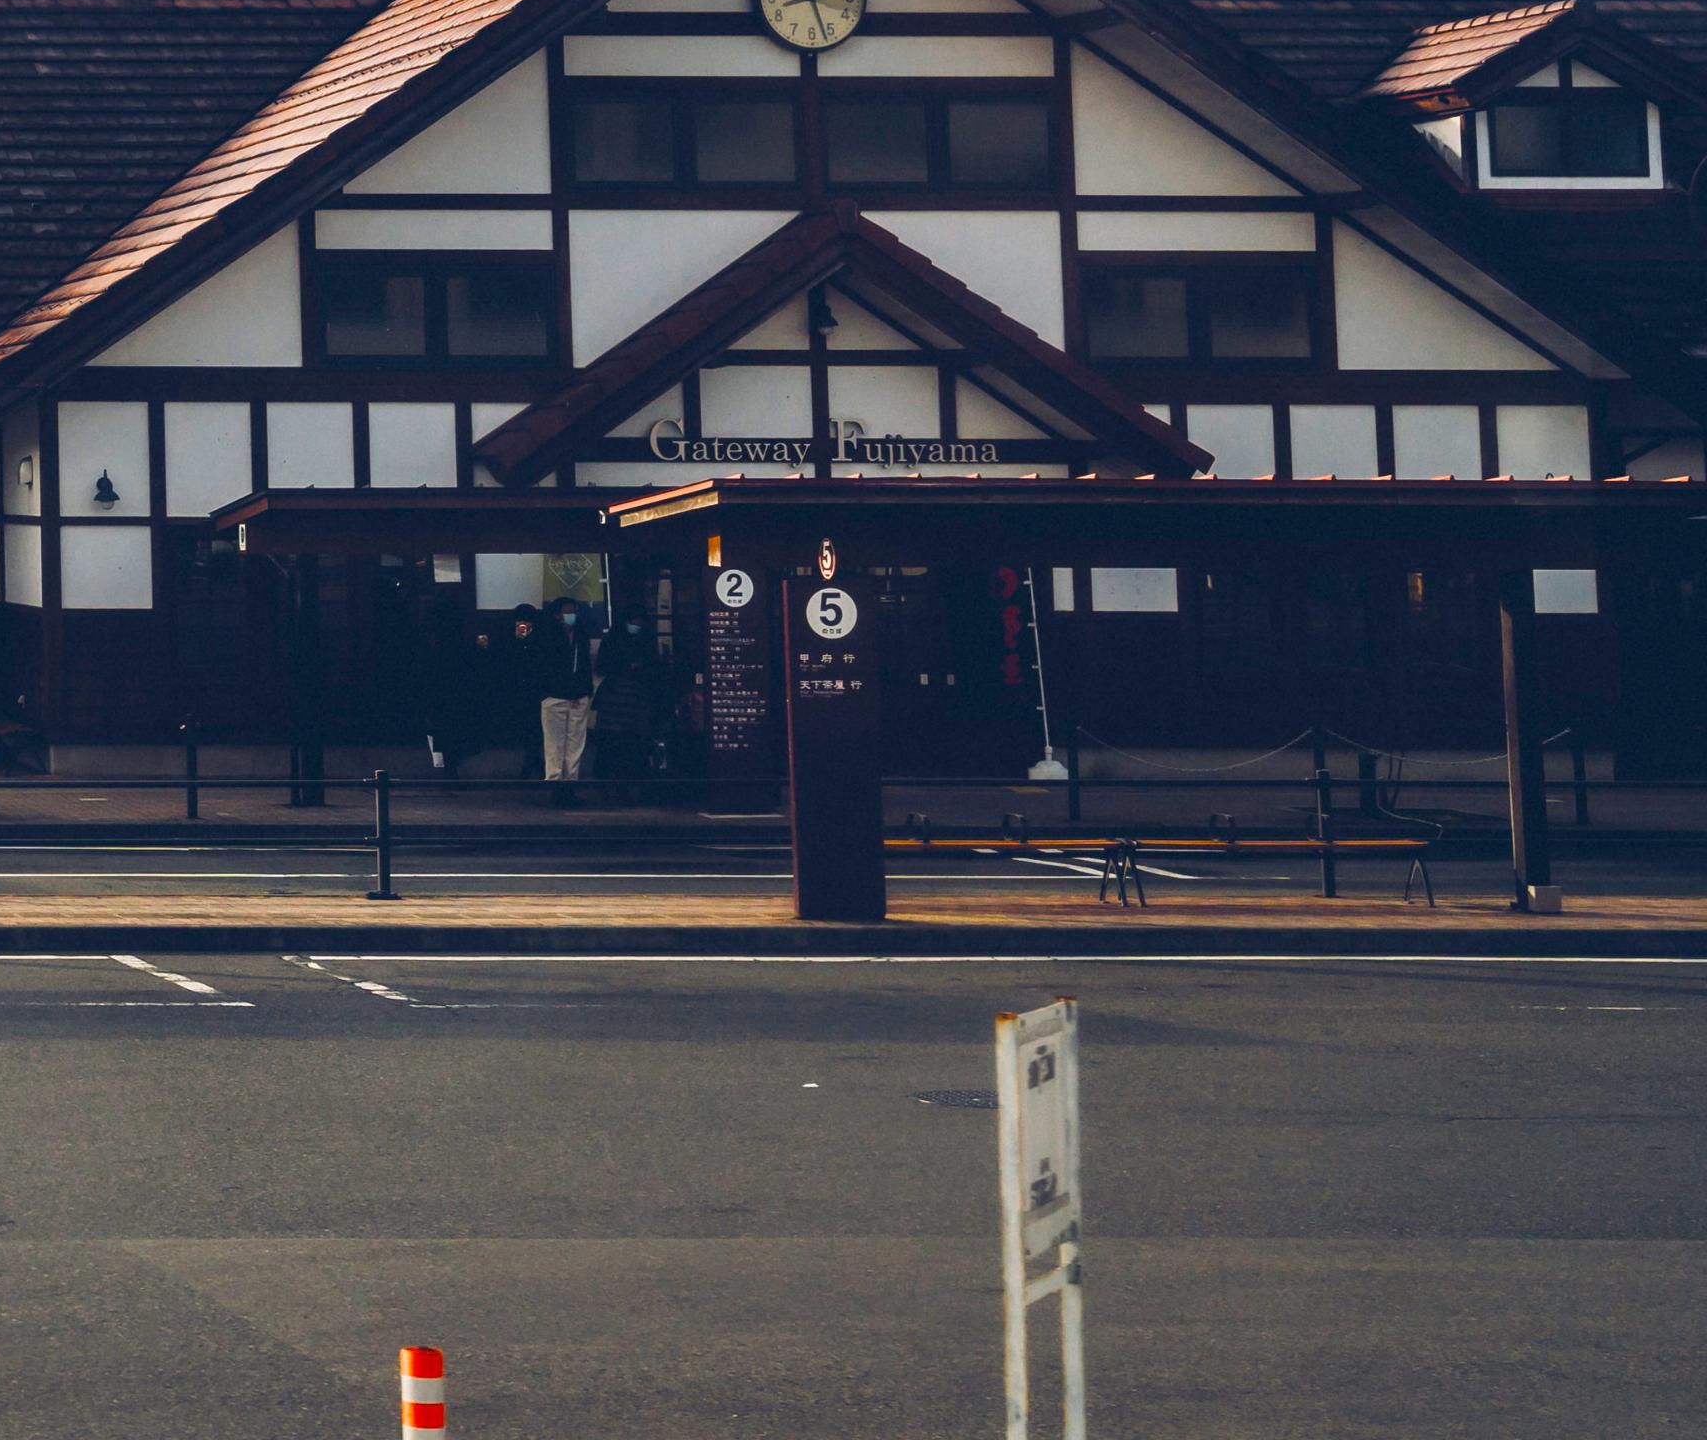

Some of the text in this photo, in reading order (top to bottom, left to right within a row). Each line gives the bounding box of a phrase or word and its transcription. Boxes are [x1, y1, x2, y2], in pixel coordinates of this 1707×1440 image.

[774, 10, 784, 22] 8
[840, 8, 850, 20] 4
[790, 23, 798, 36] 7
[808, 27, 816, 40] 6
[826, 23, 835, 36] 5
[649, 417, 1000, 469] Gateway Fujiyama
[822, 540, 832, 568] 5
[726, 573, 743, 597] 2
[820, 592, 842, 626] 5
